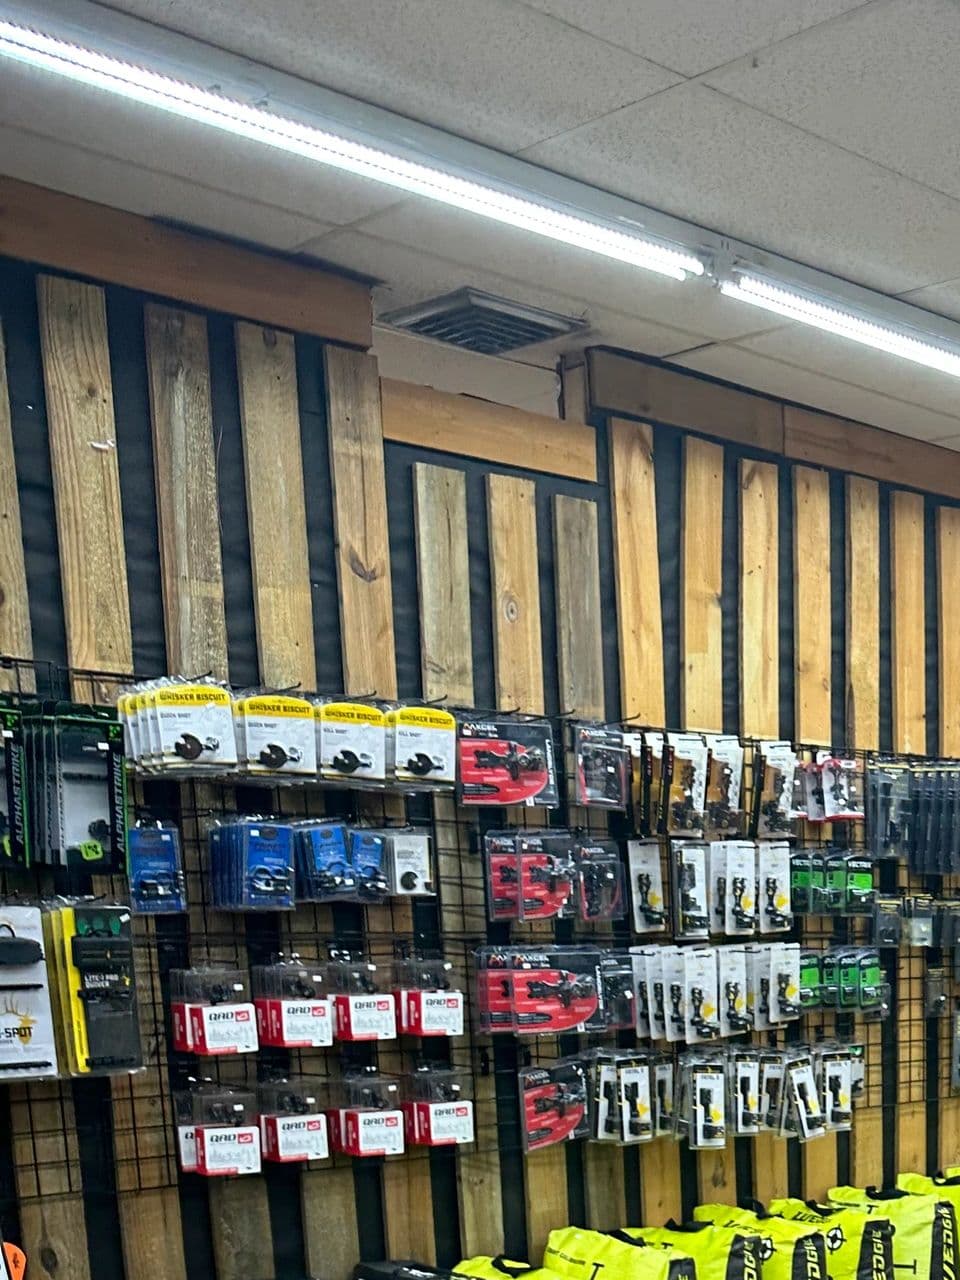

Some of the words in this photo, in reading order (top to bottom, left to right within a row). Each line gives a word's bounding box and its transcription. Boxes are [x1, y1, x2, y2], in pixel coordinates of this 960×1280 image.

[160, 692, 194, 702] WHISKER
[197, 693, 226, 702] BISCUIT
[248, 703, 281, 713] WHISKER
[282, 705, 310, 714] BISCUIT
[325, 710, 355, 719] WHISKER
[356, 712, 382, 722] BISCUIT
[400, 714, 428, 723] WHISKER
[429, 716, 453, 725] BISCUIT
[10, 742, 24, 845] ALPHASTRIKE
[112, 753, 125, 852] ALPHASTRIKE
[355, 1001, 376, 1009] QAD
[426, 998, 446, 1006] QAD
[287, 1006, 311, 1015] QAD
[209, 1012, 234, 1021] QAD
[0, 1026, 33, 1038] -SPOT
[434, 1108, 455, 1116] QAD
[363, 1117, 384, 1126] QAD
[282, 1122, 306, 1131] QAD
[210, 1134, 236, 1143] QAD
